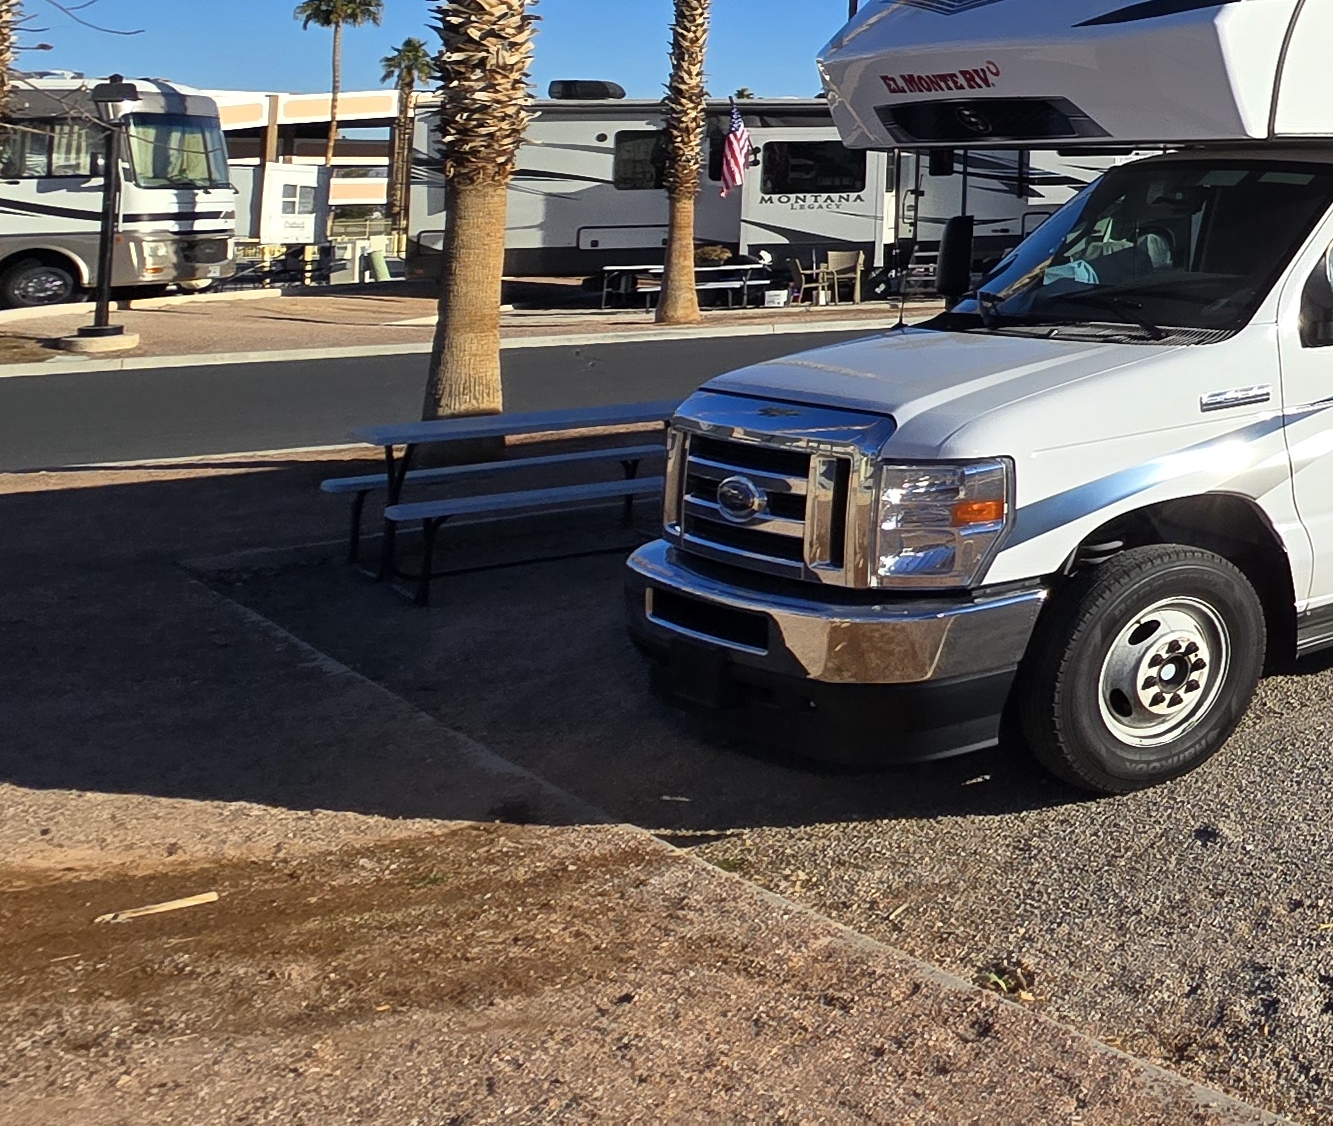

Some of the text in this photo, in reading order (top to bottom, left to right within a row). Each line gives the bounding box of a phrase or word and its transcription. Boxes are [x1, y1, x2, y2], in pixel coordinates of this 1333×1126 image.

[879, 75, 907, 93] EL
[899, 73, 966, 92] MONTE
[759, 194, 865, 204] MONTANA
